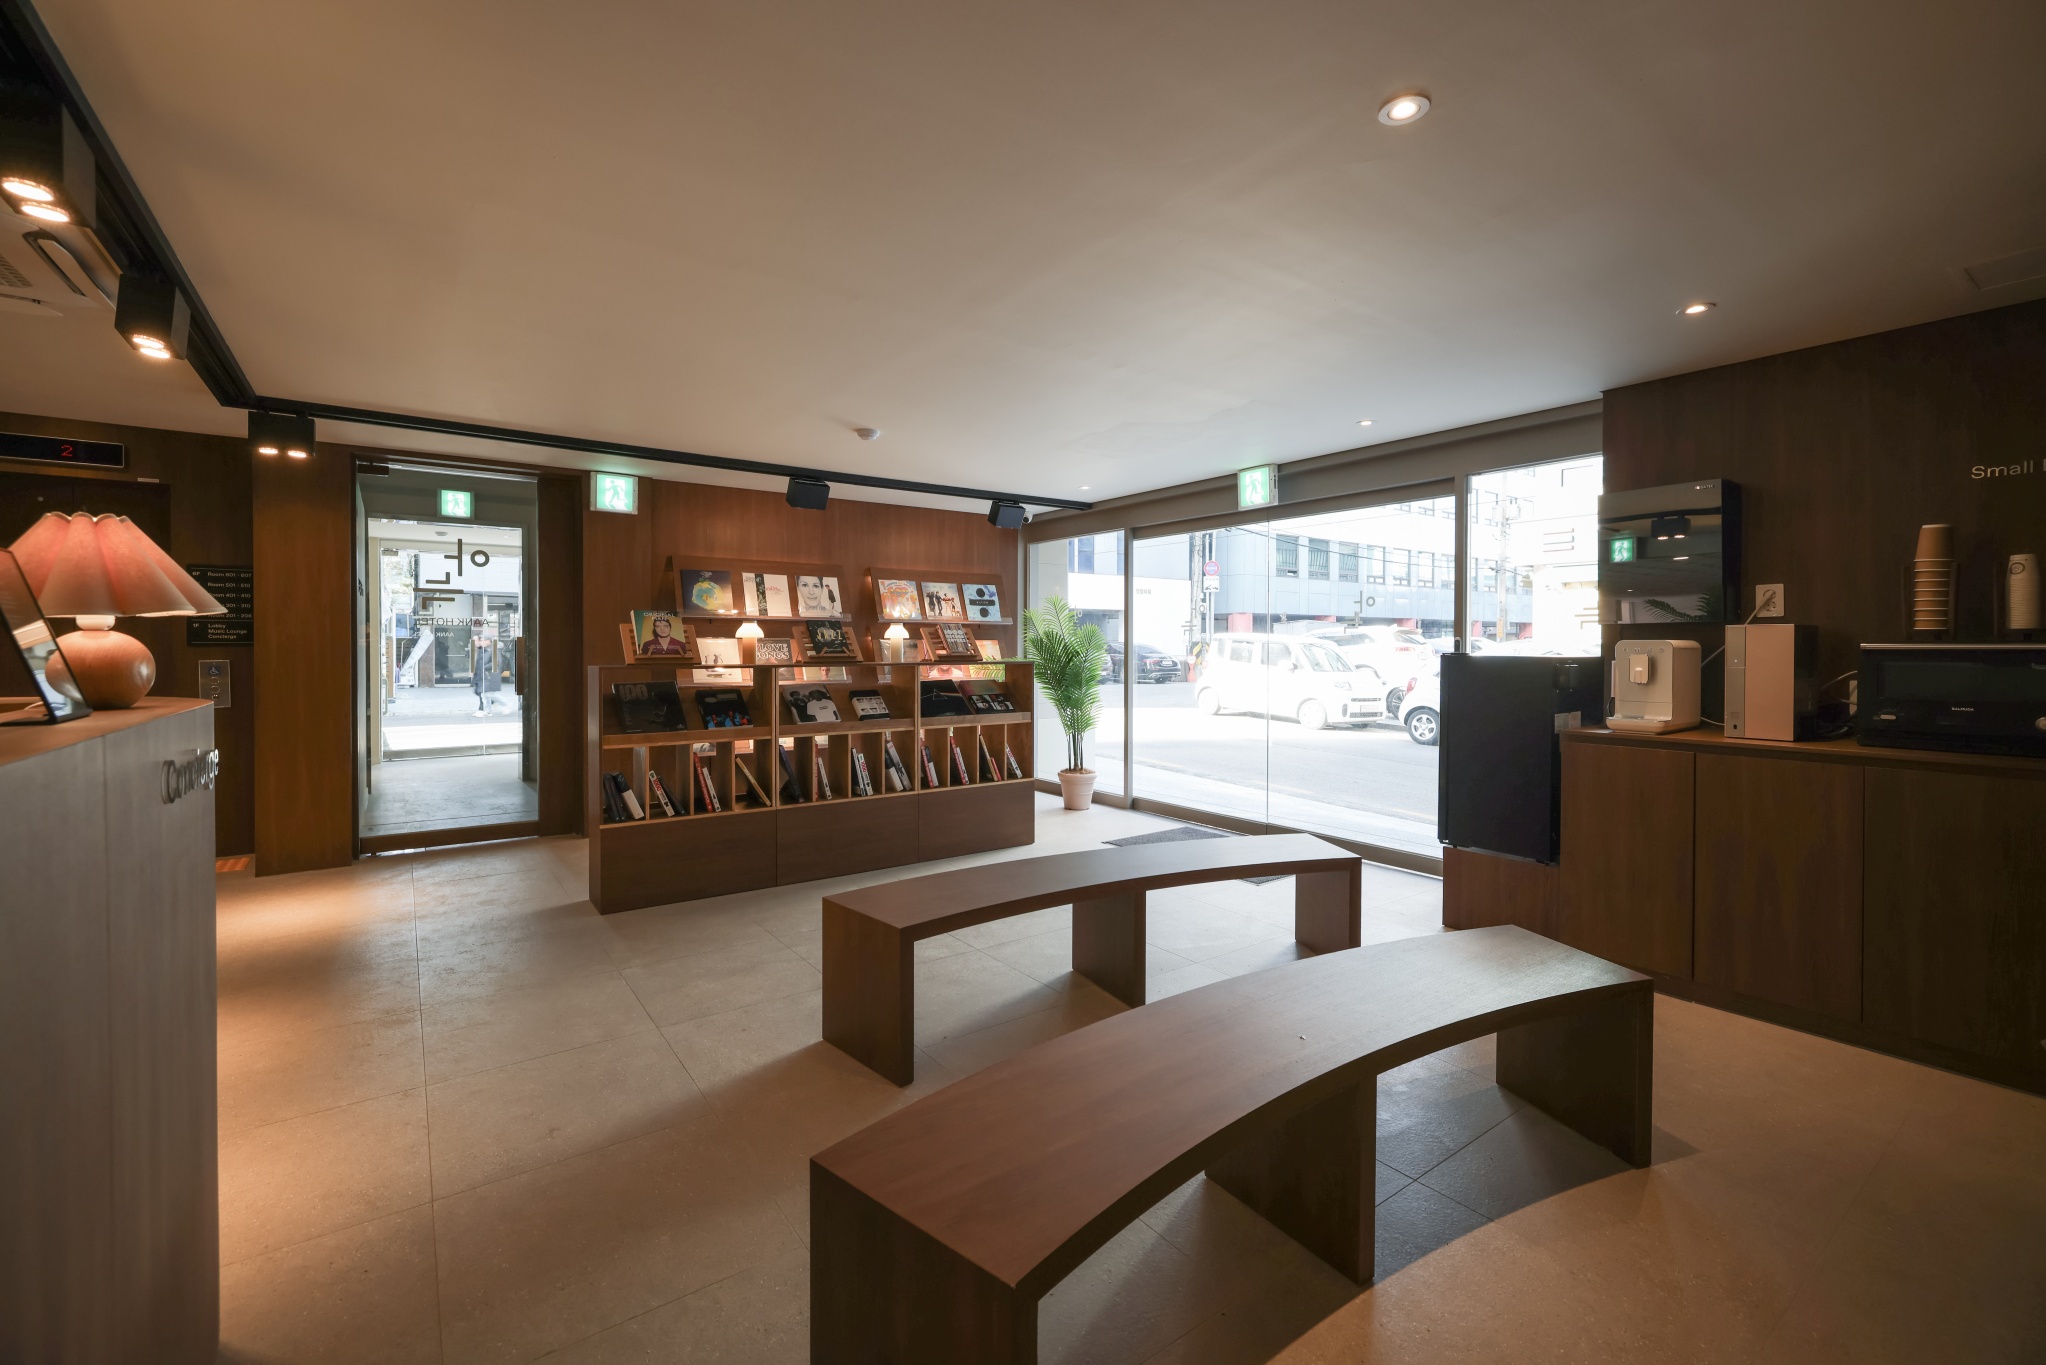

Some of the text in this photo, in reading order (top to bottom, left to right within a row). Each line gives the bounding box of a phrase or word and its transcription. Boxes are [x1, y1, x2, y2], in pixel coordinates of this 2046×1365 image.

[61, 444, 73, 457] 2
[1971, 460, 2034, 479] Small
[760, 643, 789, 652] LOVE
